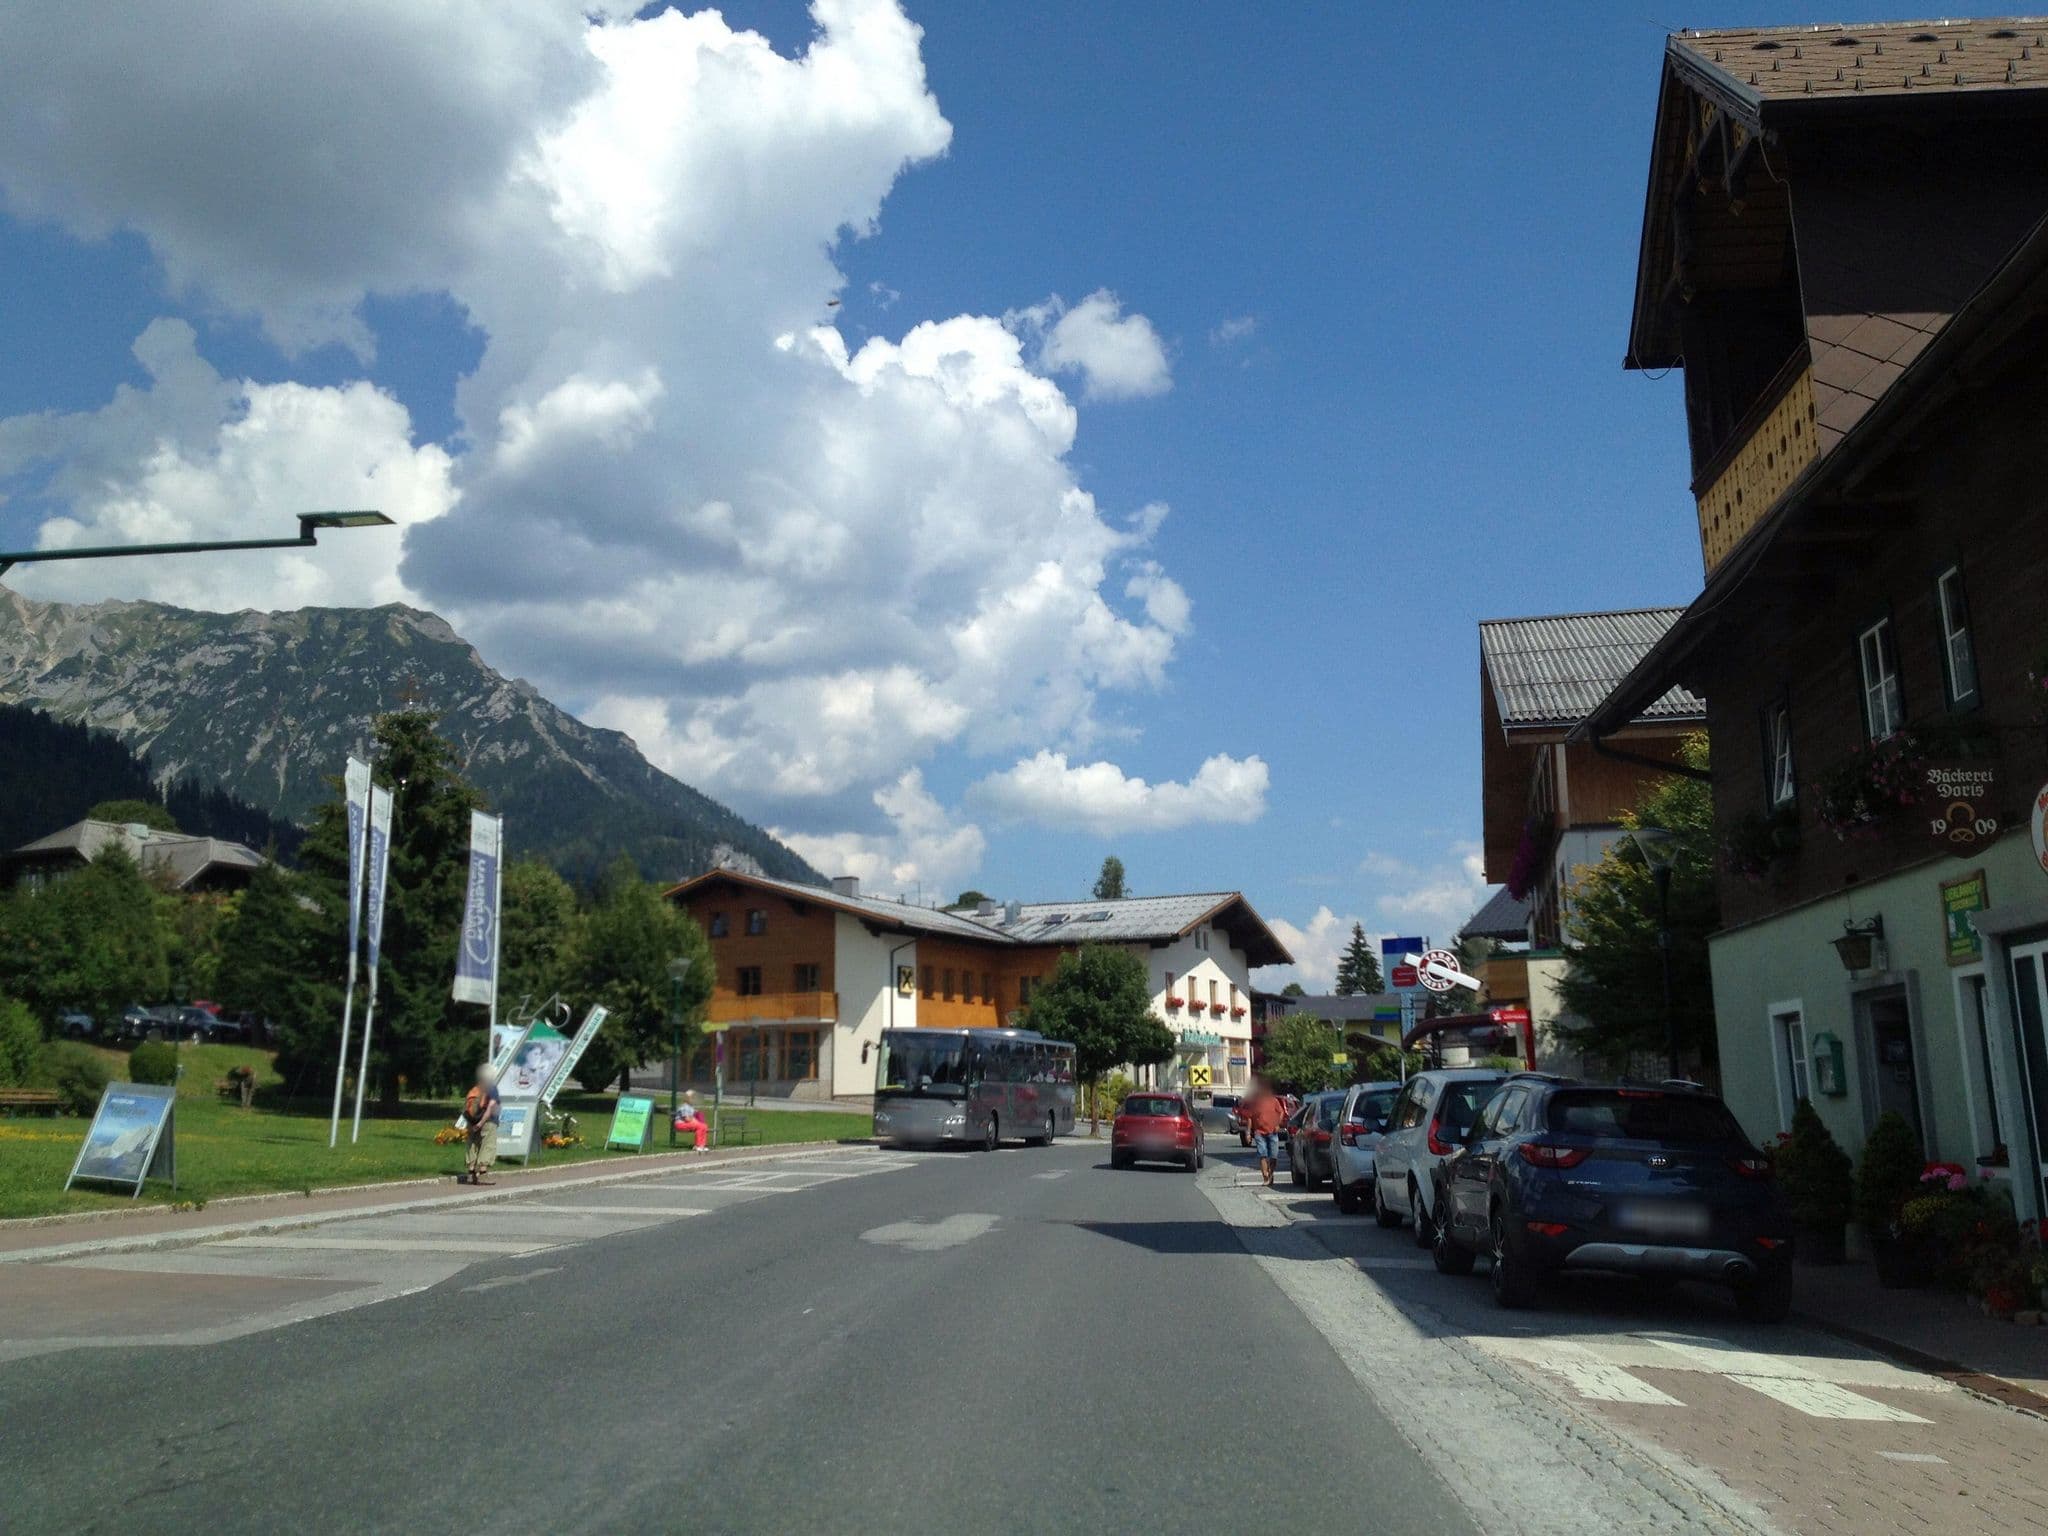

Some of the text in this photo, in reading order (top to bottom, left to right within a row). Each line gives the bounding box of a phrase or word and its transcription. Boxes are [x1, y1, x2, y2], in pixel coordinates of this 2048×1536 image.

[1926, 768, 1994, 784] Bäckerei
[1937, 783, 1985, 798] Doris
[1930, 818, 1998, 835] 19 09
[1426, 952, 1457, 968] TABAK
[1419, 966, 1449, 989] TRAFIK
[1651, 1158, 1666, 1166] KIA
